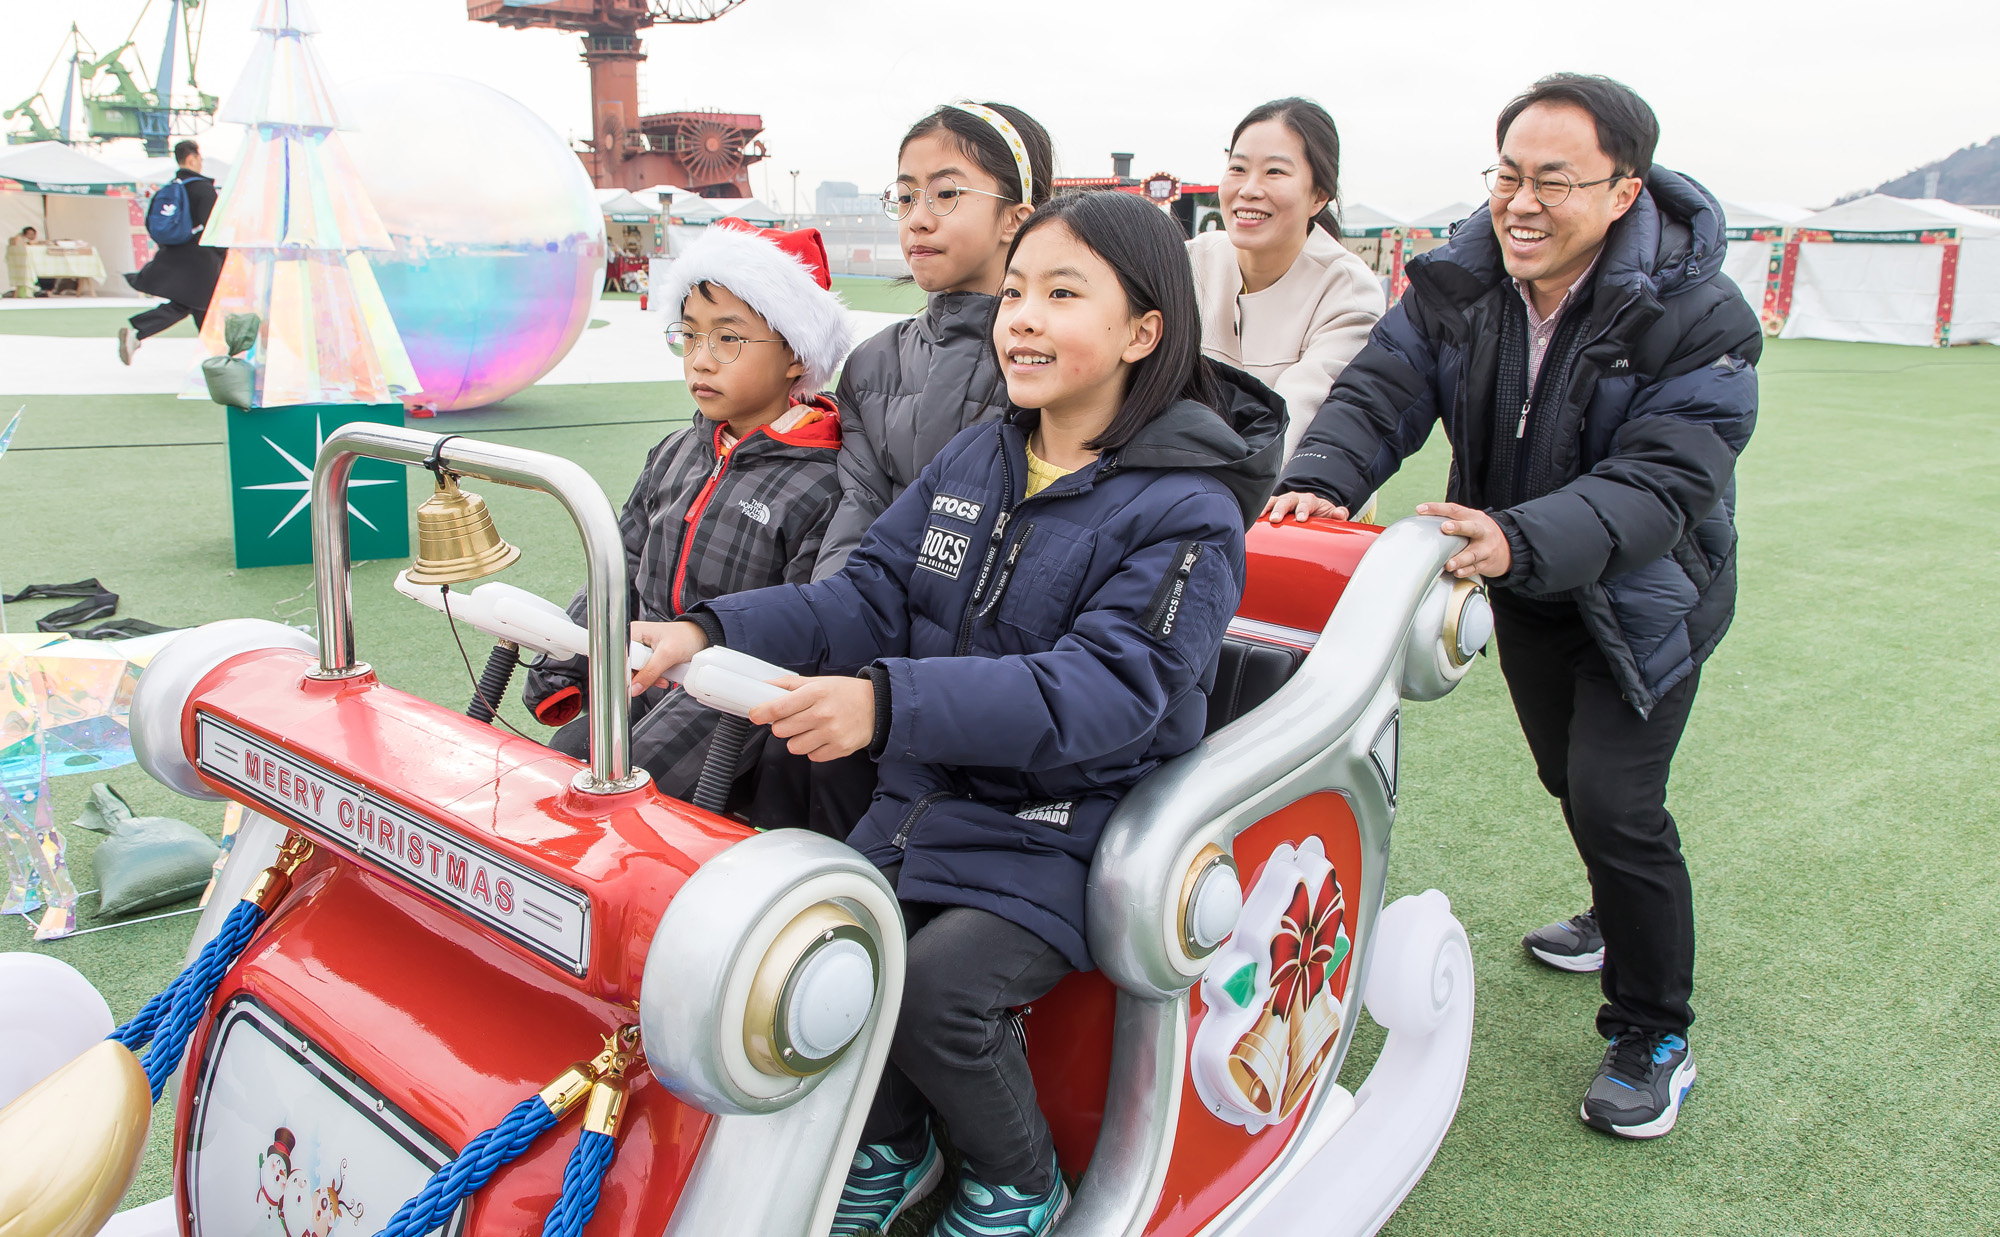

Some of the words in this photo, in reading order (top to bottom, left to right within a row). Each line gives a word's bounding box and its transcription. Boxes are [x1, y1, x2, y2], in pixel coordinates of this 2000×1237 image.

[1611, 359, 1629, 368] PA
[751, 498, 764, 509] THE
[932, 495, 980, 520] crocs
[741, 507, 760, 520] FACE
[920, 529, 966, 565] ROCS
[244, 749, 325, 816] MEERY
[337, 799, 516, 916] CHRISTMAS
